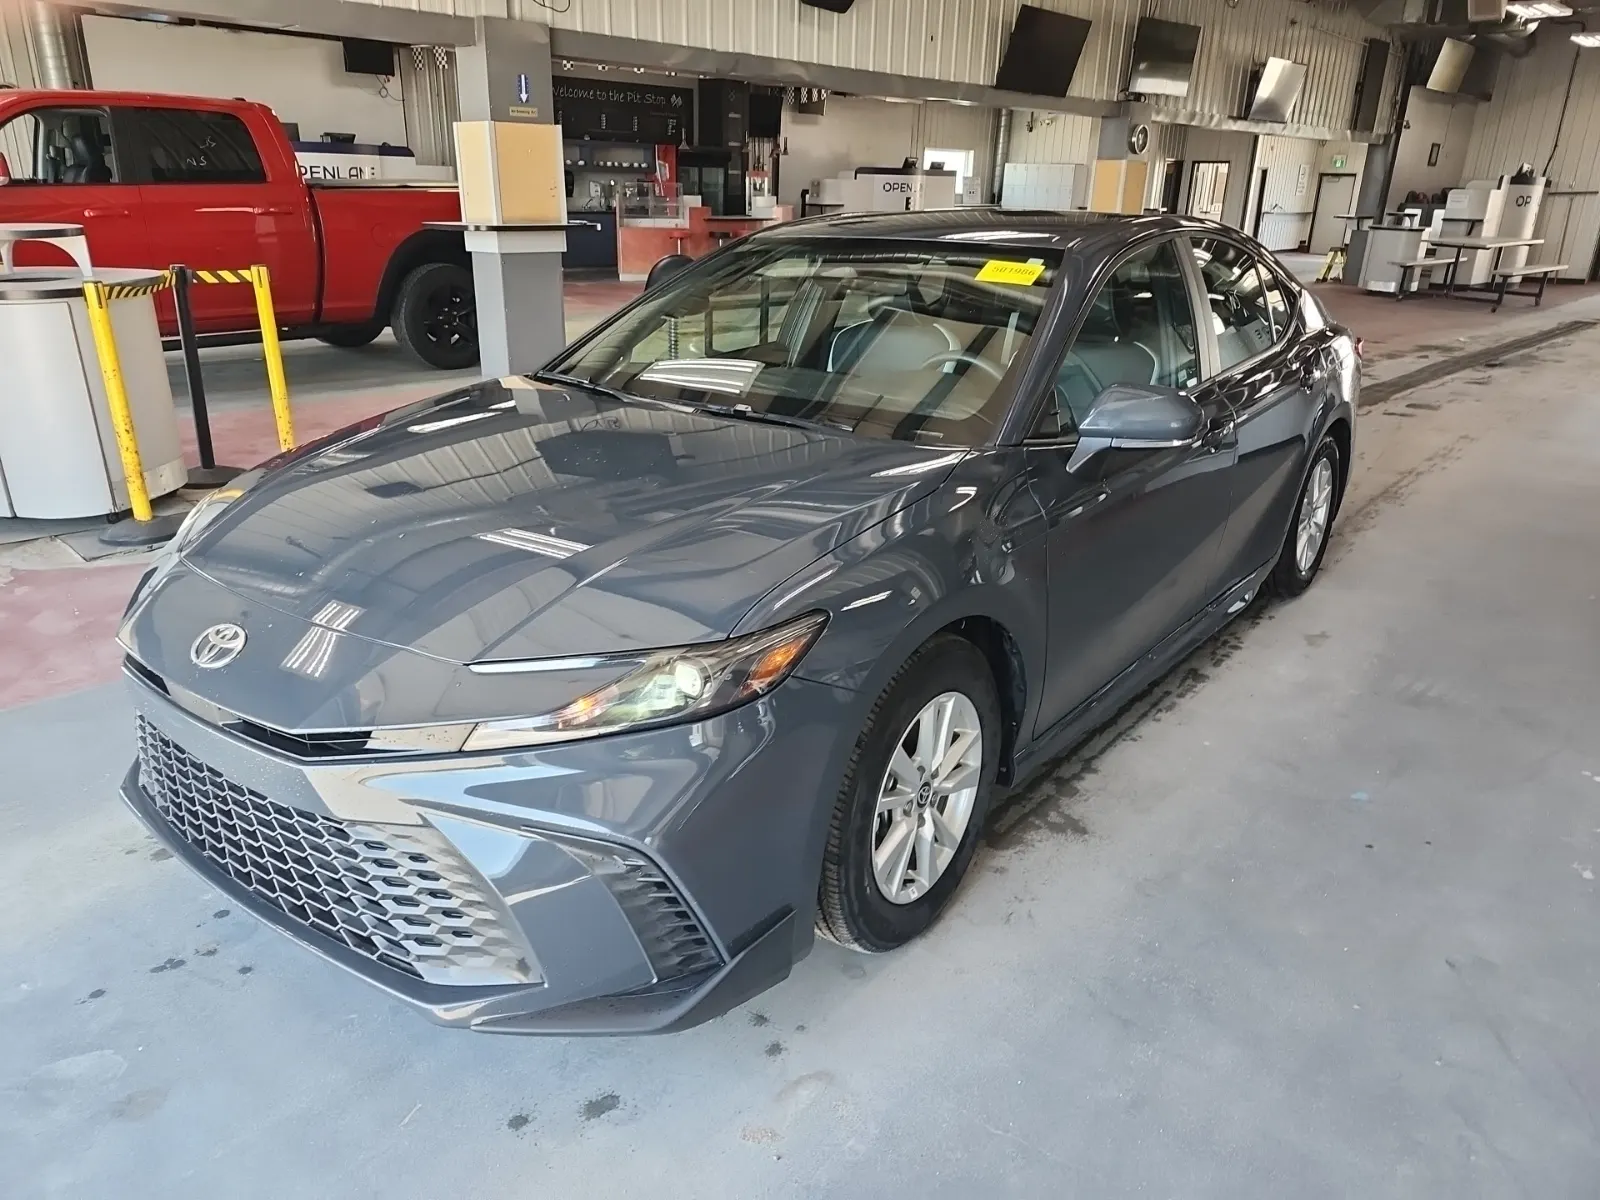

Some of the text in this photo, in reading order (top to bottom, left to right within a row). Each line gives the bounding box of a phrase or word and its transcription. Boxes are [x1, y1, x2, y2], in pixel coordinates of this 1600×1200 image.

[597, 89, 607, 100] to
[609, 89, 625, 103] the
[627, 91, 642, 104] Pit
[644, 94, 667, 108] Stop
